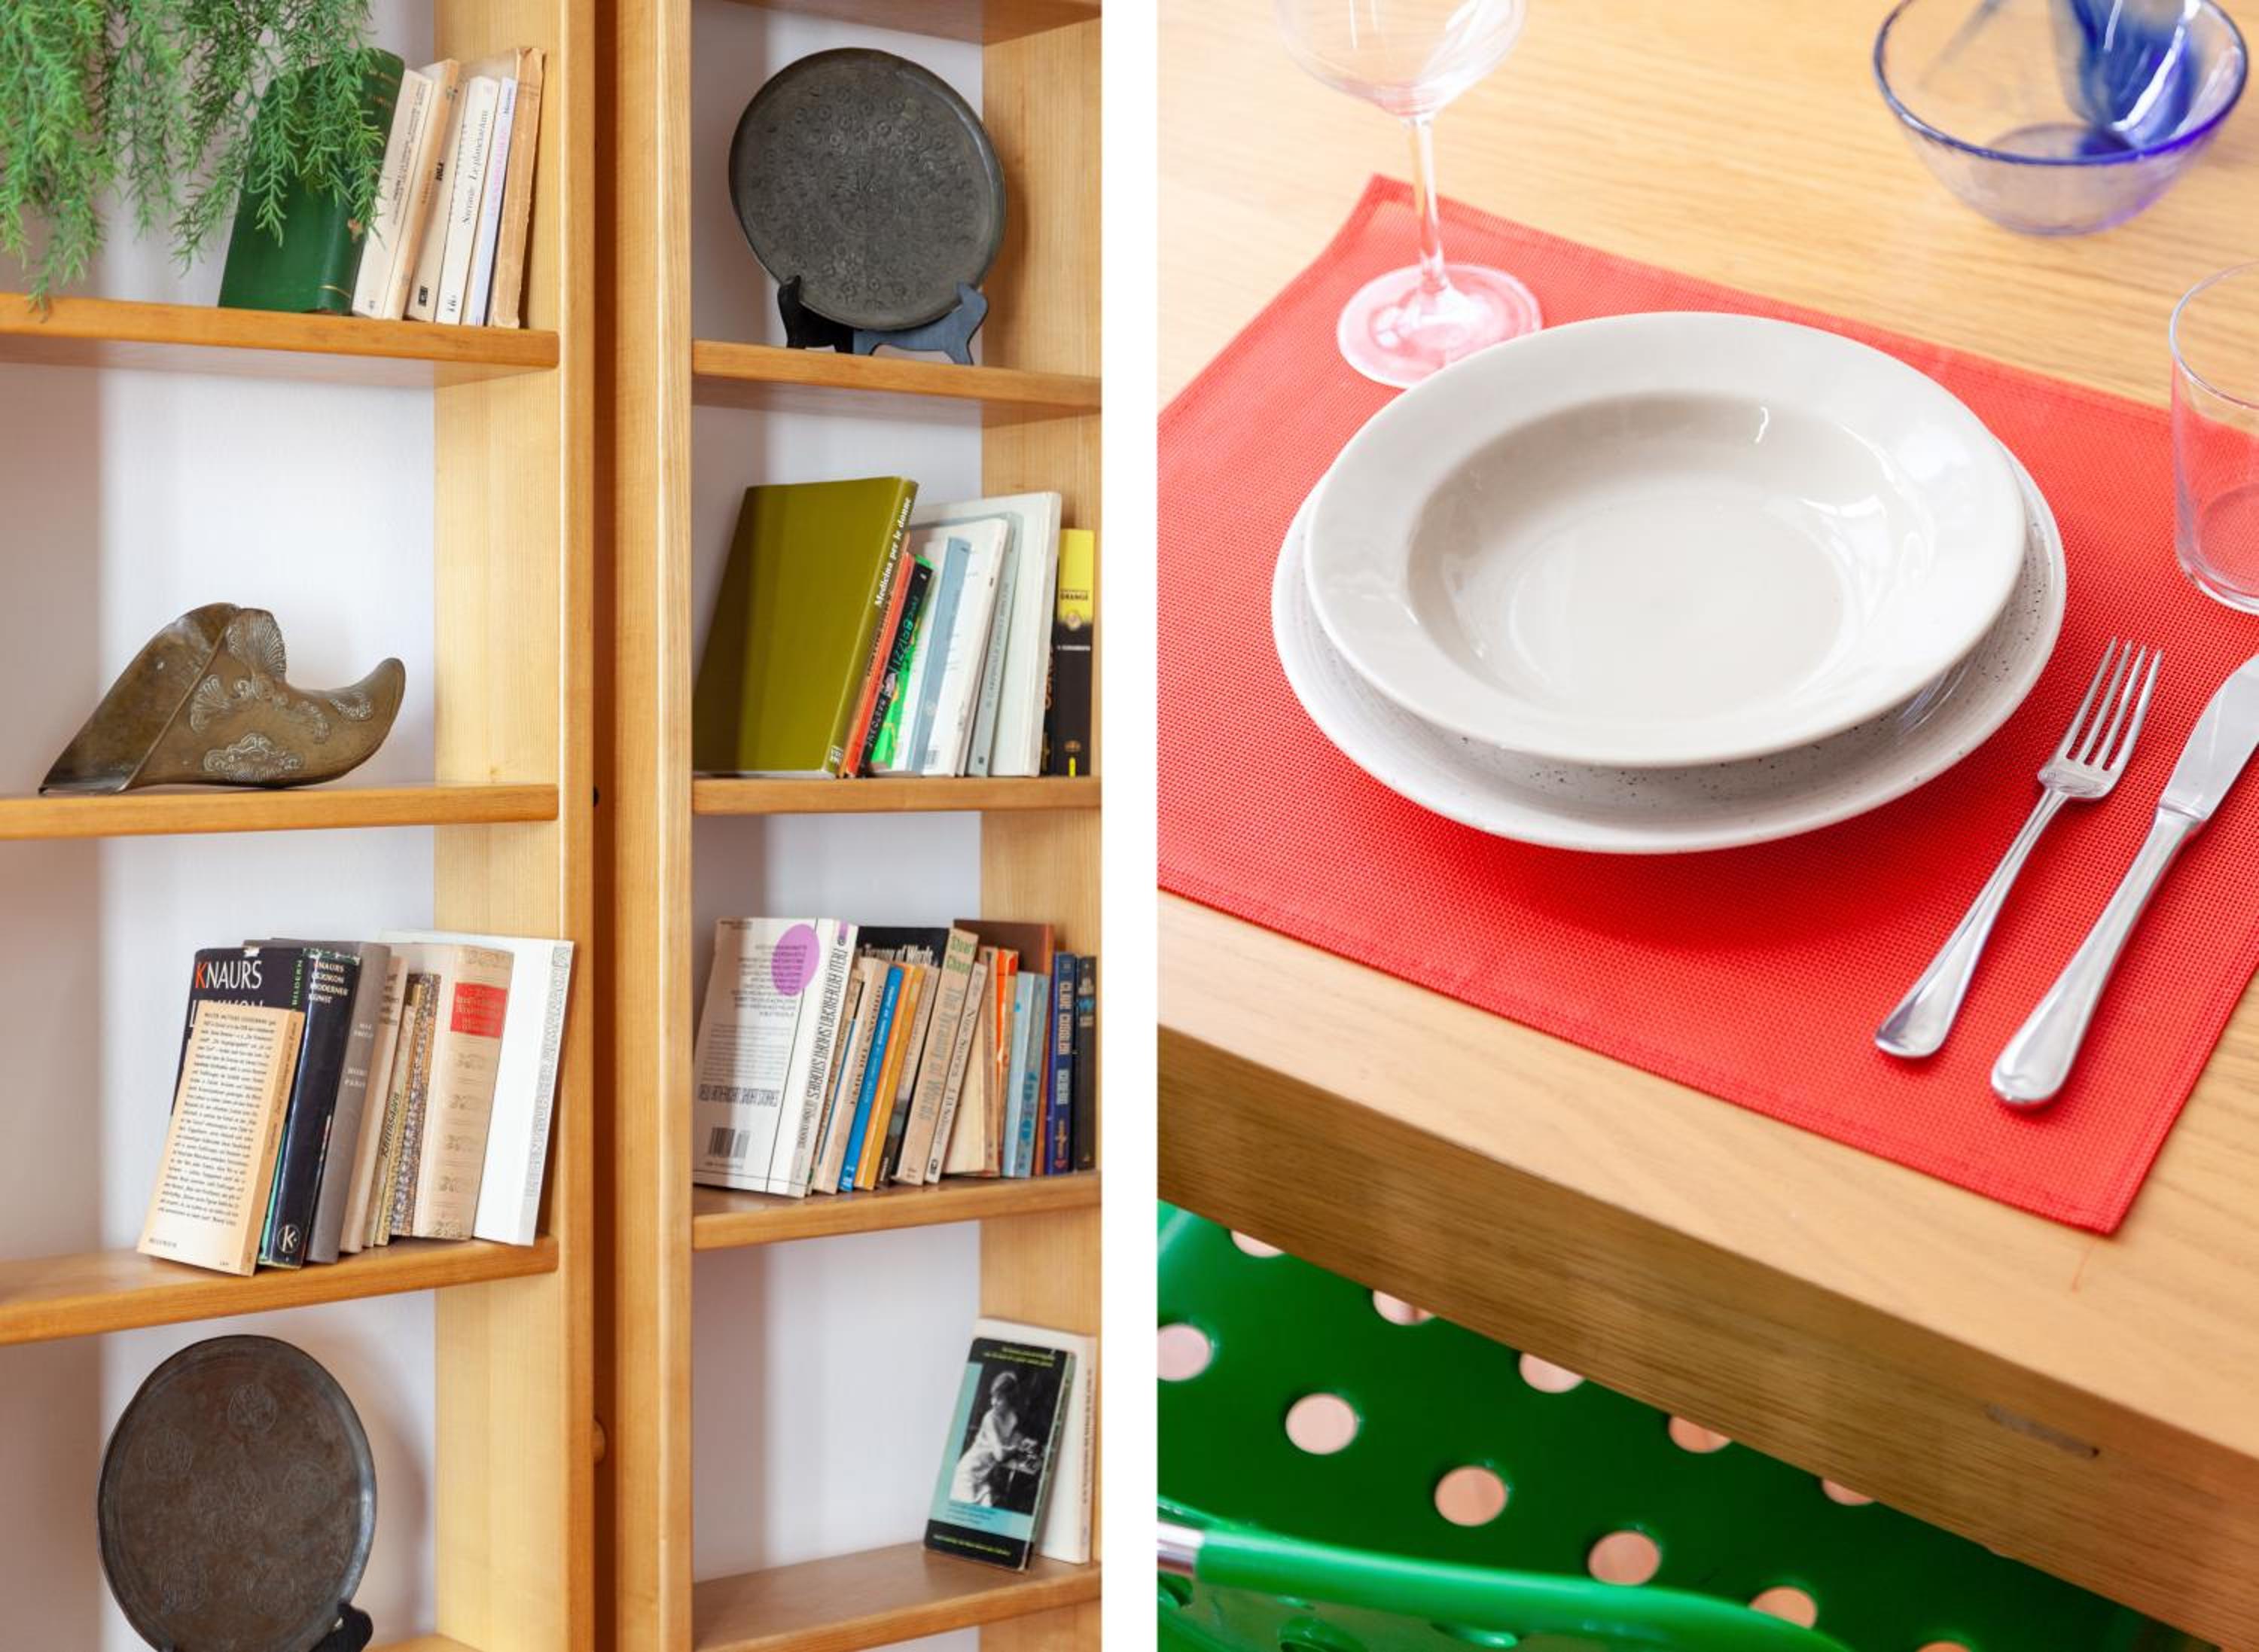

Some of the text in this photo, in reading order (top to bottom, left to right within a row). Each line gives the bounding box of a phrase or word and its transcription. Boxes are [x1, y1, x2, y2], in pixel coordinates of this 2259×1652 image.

[897, 498, 911, 528] donne
[889, 541, 900, 560] per
[894, 529, 902, 540] le
[875, 561, 893, 607] Medicina
[195, 960, 263, 989] KNAURS
[291, 960, 303, 1005] BILDERN
[821, 972, 843, 1027] AMERICAN
[813, 1027, 833, 1059] SHORT
[806, 1059, 825, 1100] STORIES
